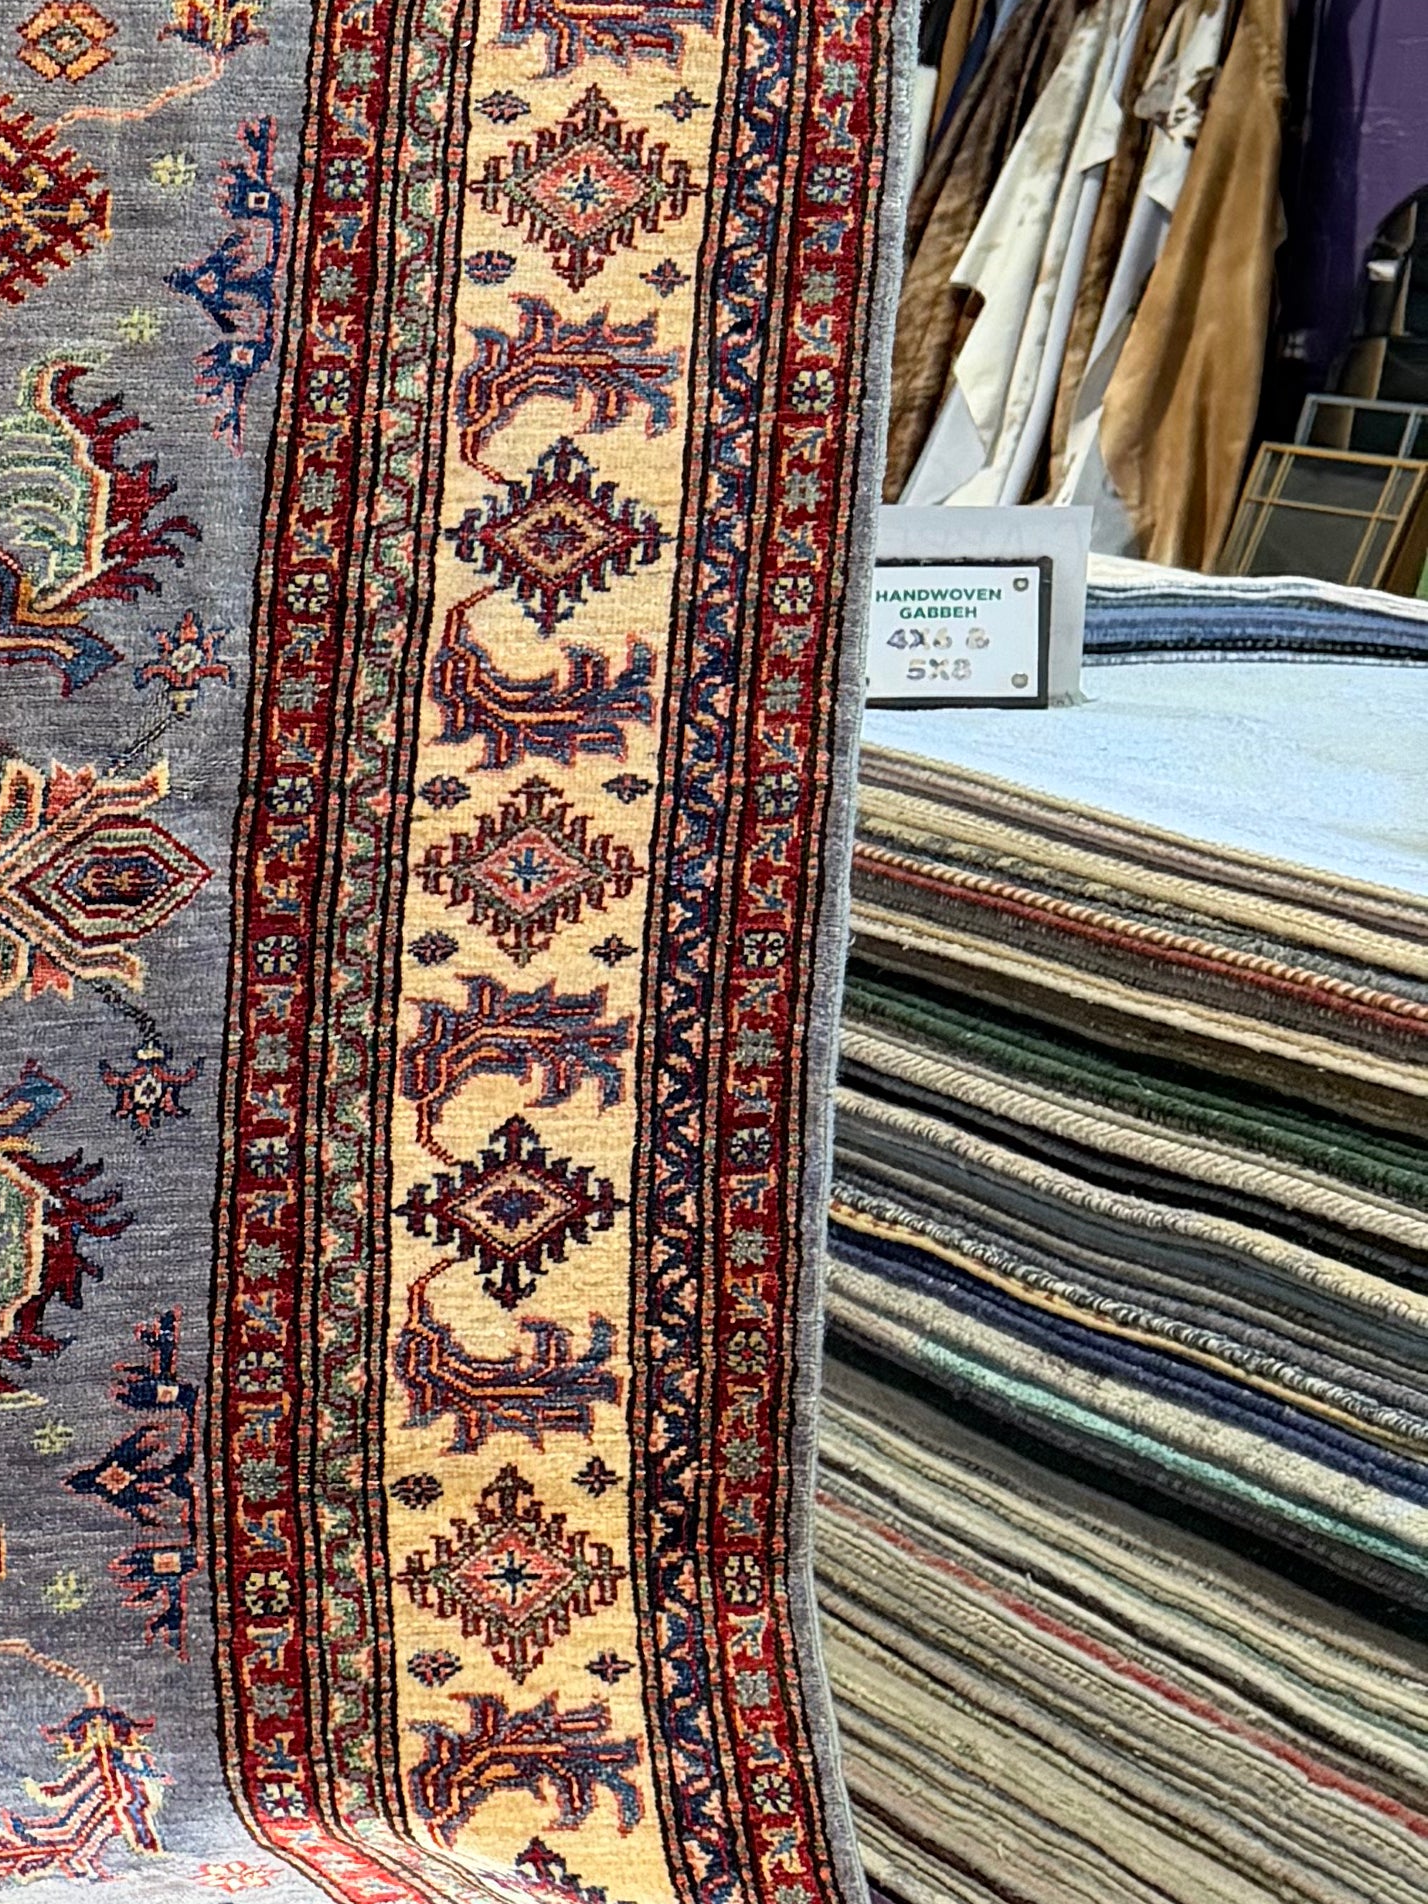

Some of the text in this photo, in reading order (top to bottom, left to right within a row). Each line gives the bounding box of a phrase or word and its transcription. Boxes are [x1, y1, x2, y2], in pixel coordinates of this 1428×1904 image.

[876, 588, 1001, 602] HANDWOVEN
[899, 606, 977, 619] GABBEH
[886, 627, 953, 650] 4X6
[906, 658, 972, 681] 5X8
